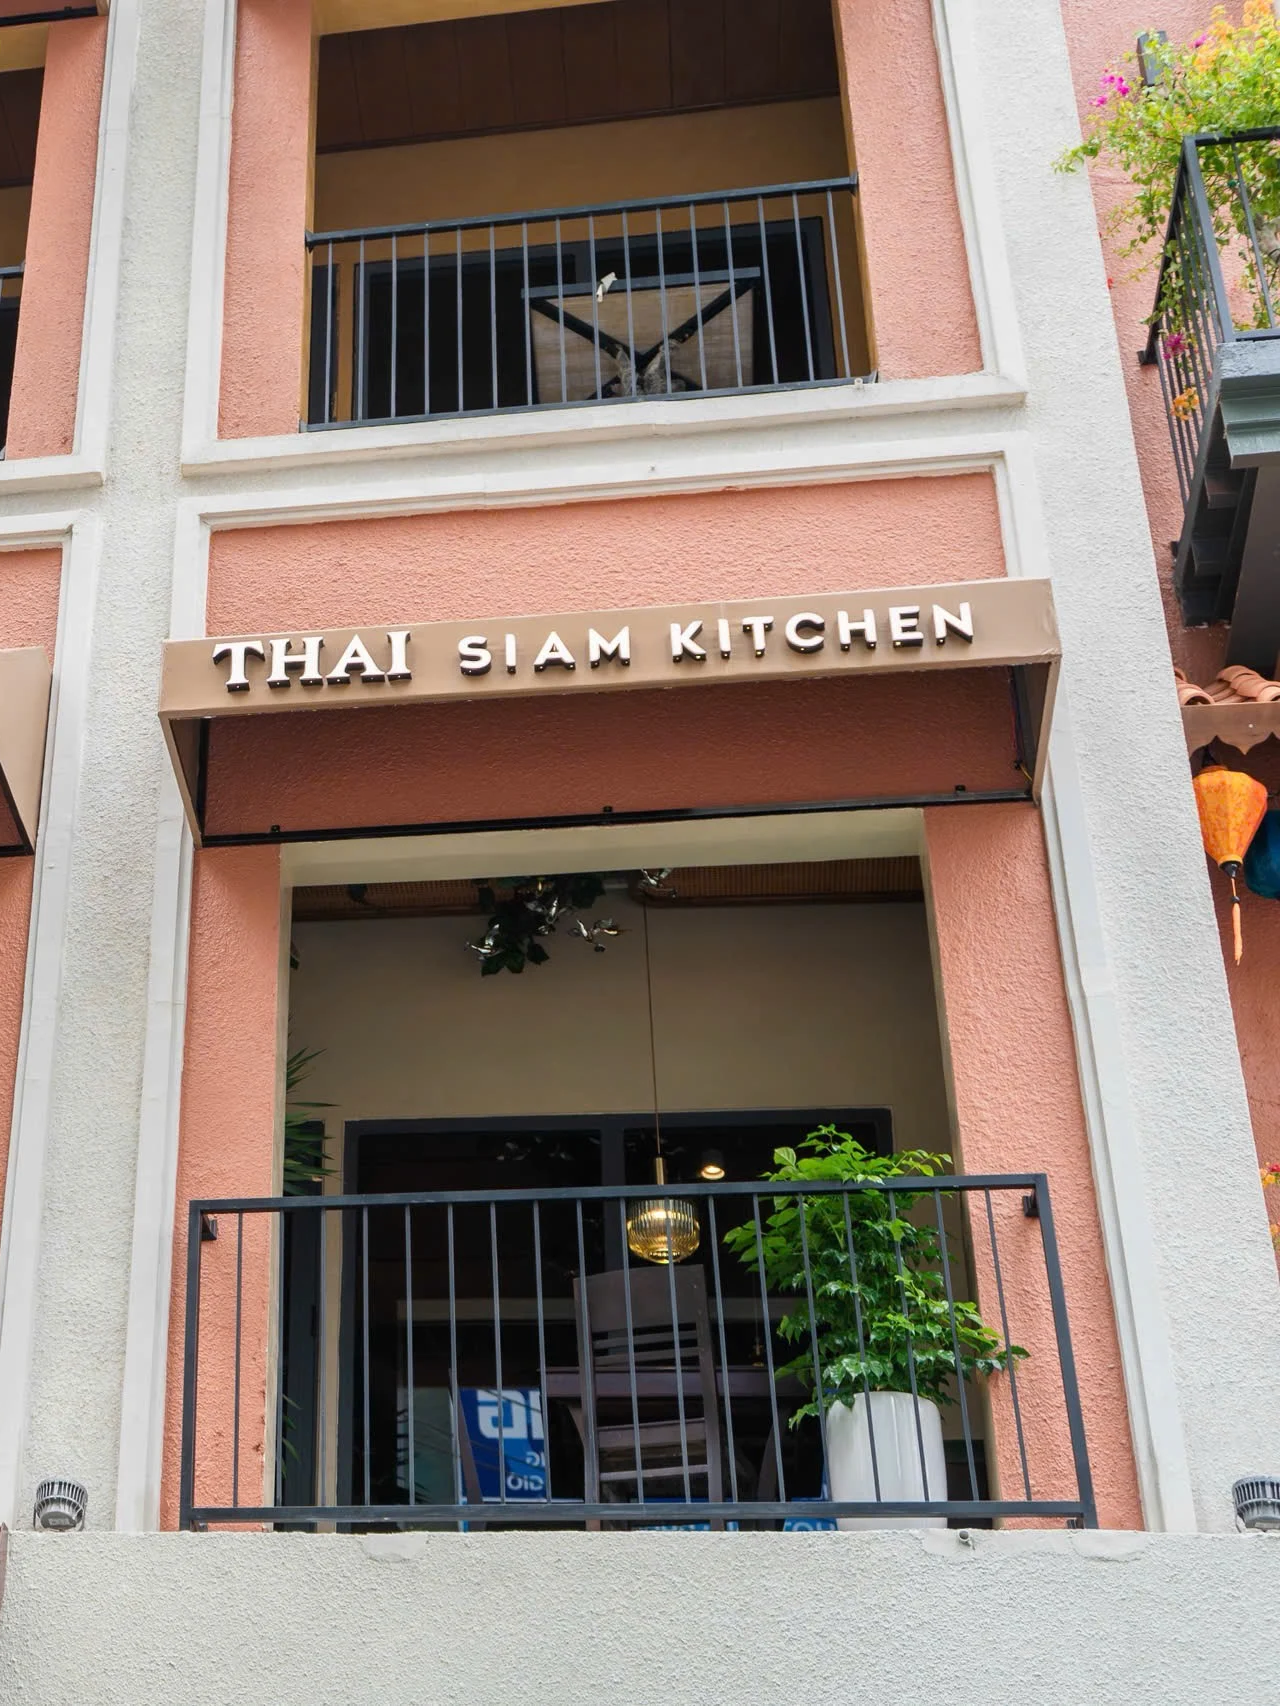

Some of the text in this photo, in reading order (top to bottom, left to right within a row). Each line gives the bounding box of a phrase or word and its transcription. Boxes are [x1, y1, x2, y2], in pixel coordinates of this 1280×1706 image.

[213, 602, 975, 692] THAI SIAM KITCHEN
